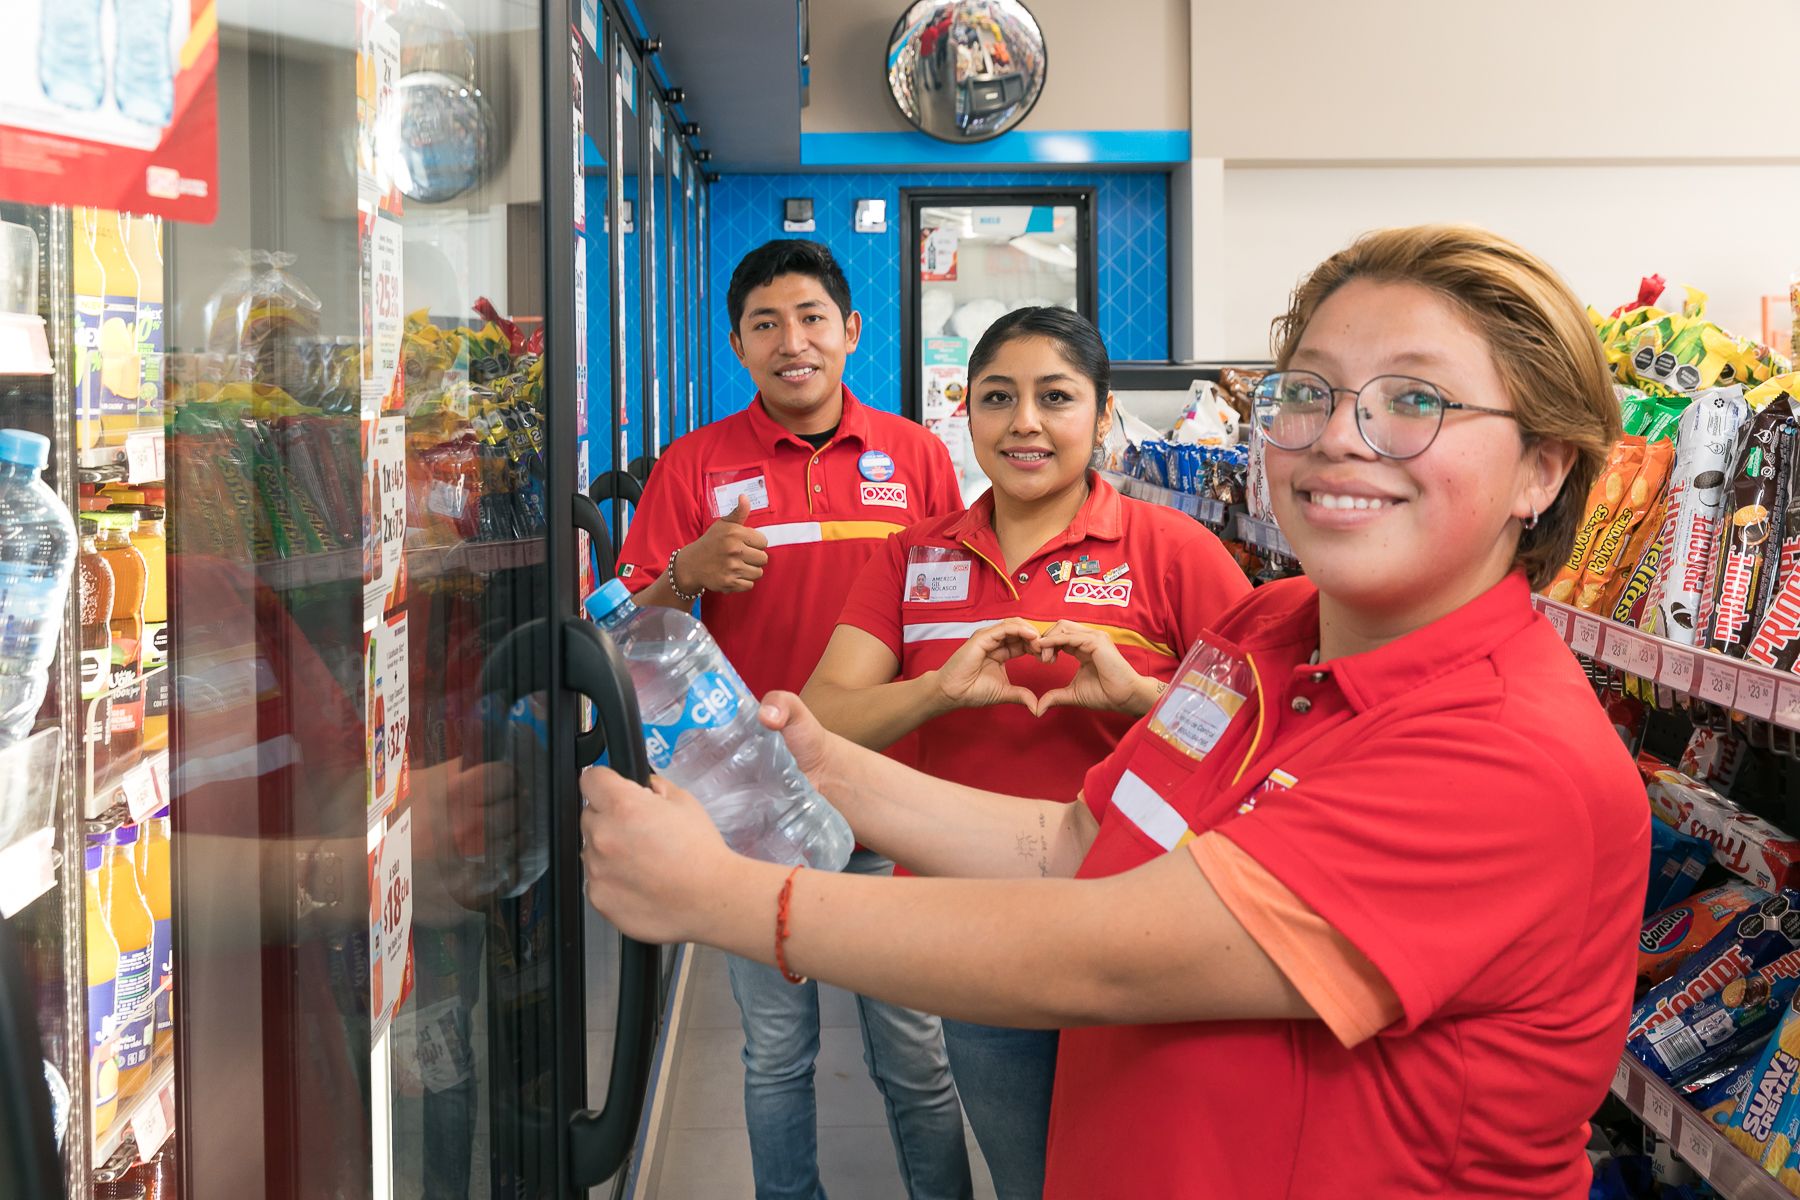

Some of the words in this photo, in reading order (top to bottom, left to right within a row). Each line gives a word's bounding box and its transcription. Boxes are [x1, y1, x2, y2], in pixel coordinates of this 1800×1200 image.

[864, 486, 905, 503] OXXO
[1587, 508, 1633, 575] Polvorones
[1072, 583, 1127, 600] OXXO
[691, 677, 734, 724] ciel
[1711, 678, 1723, 693] $23
[1748, 684, 1760, 699] $23
[383, 877, 402, 936] $18
[1640, 908, 1689, 951] Gansito
[1755, 1057, 1800, 1142] CREMAS
